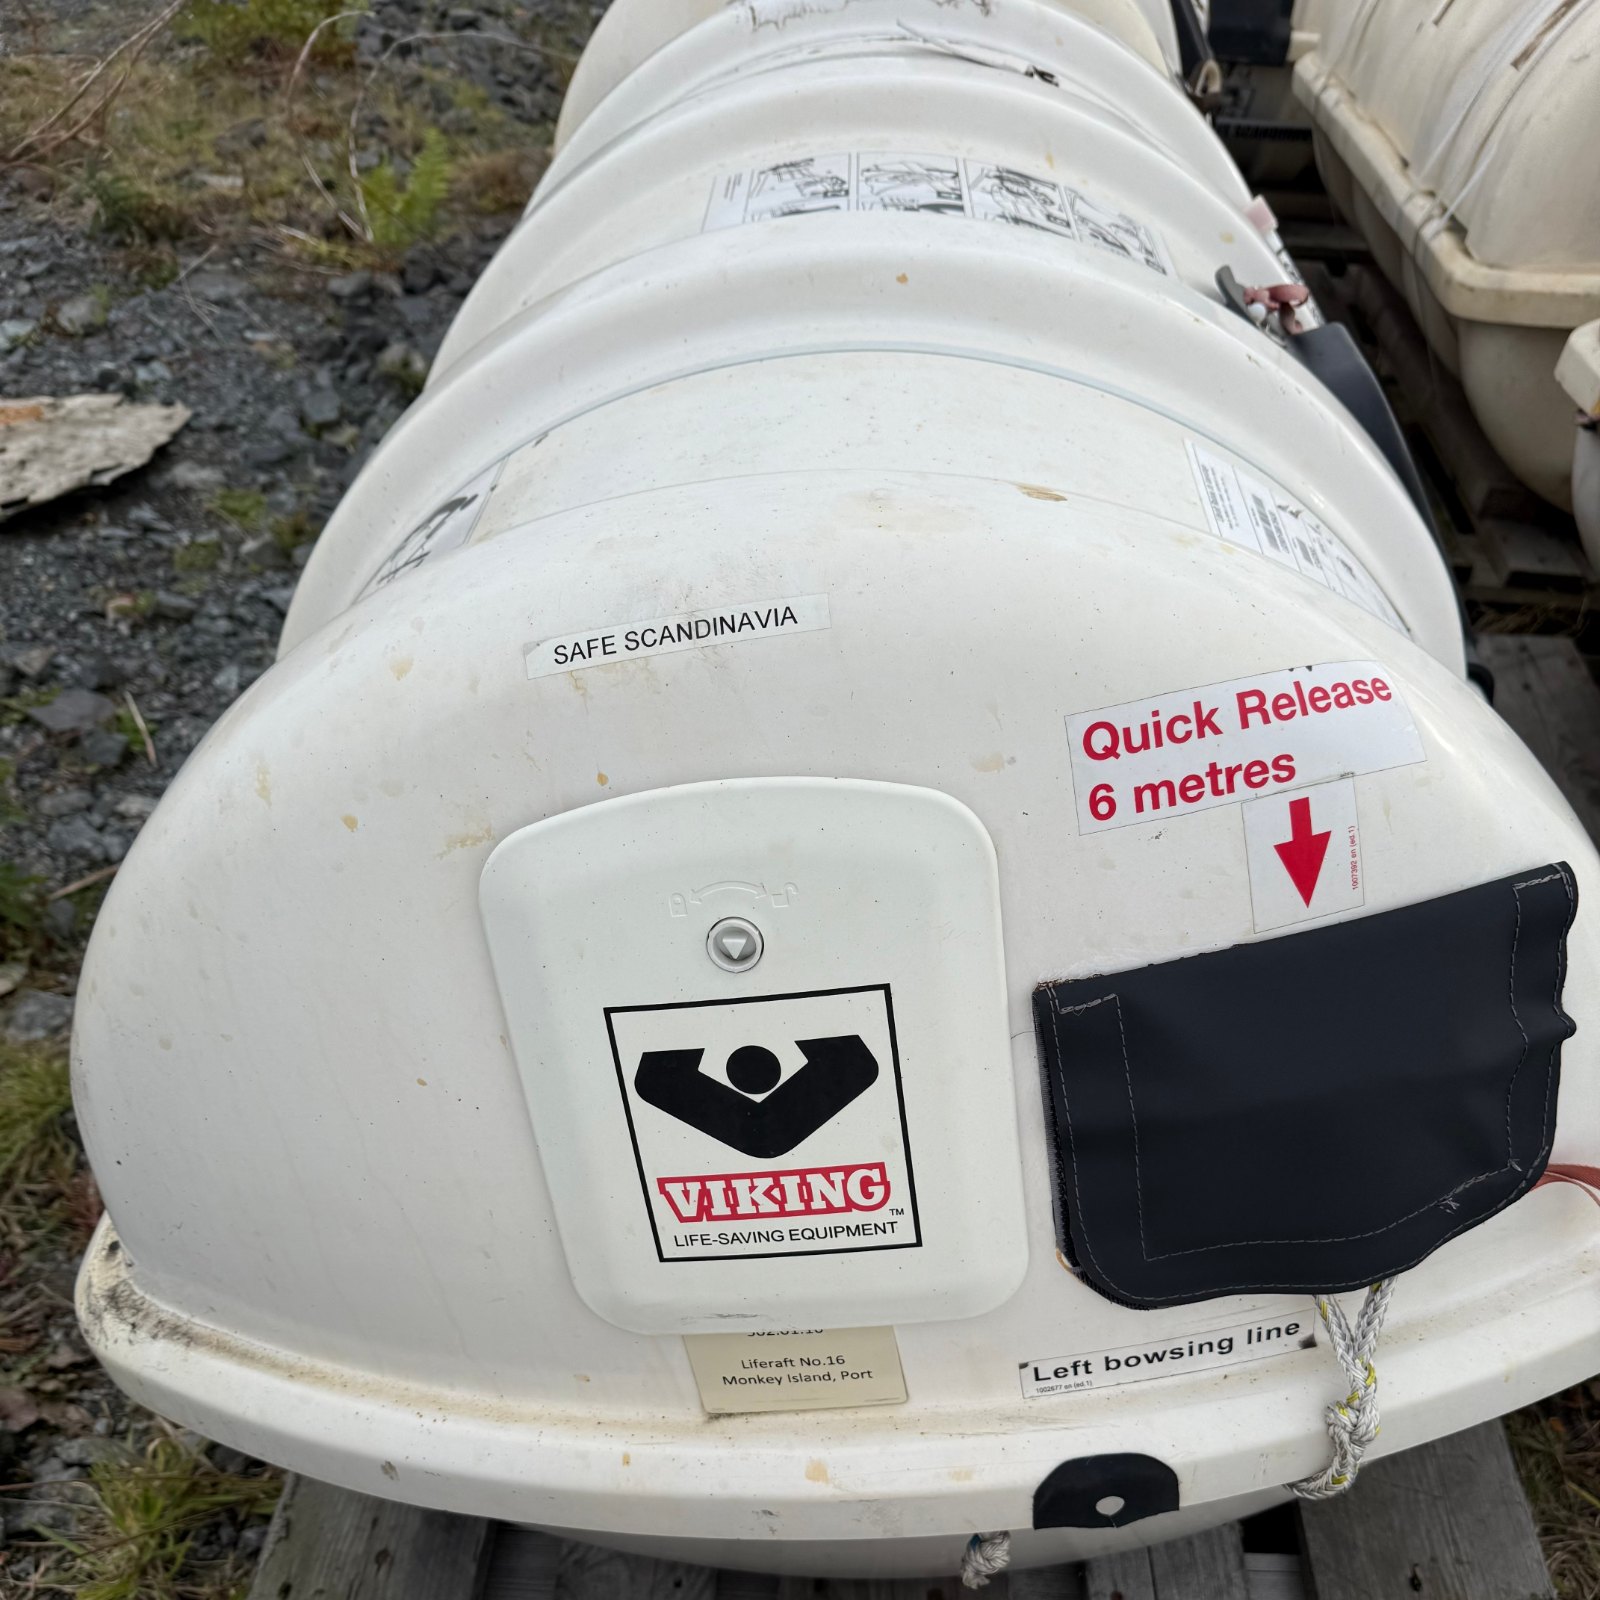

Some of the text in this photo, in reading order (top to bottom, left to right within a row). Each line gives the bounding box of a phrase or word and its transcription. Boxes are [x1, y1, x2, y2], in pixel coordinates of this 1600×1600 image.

[553, 606, 798, 665] SAFE SCANDINAVIA
[1082, 677, 1392, 761] Quick Release
[1088, 753, 1296, 821] 6 metres
[657, 1162, 891, 1223] VIKING
[673, 1221, 899, 1247] LIFE-SAVING EQUIPMENT
[722, 1368, 873, 1386] Monkey Island, Port
[741, 1354, 846, 1370] Liferaft No.16
[1033, 1321, 1300, 1382] Left bowsing line
